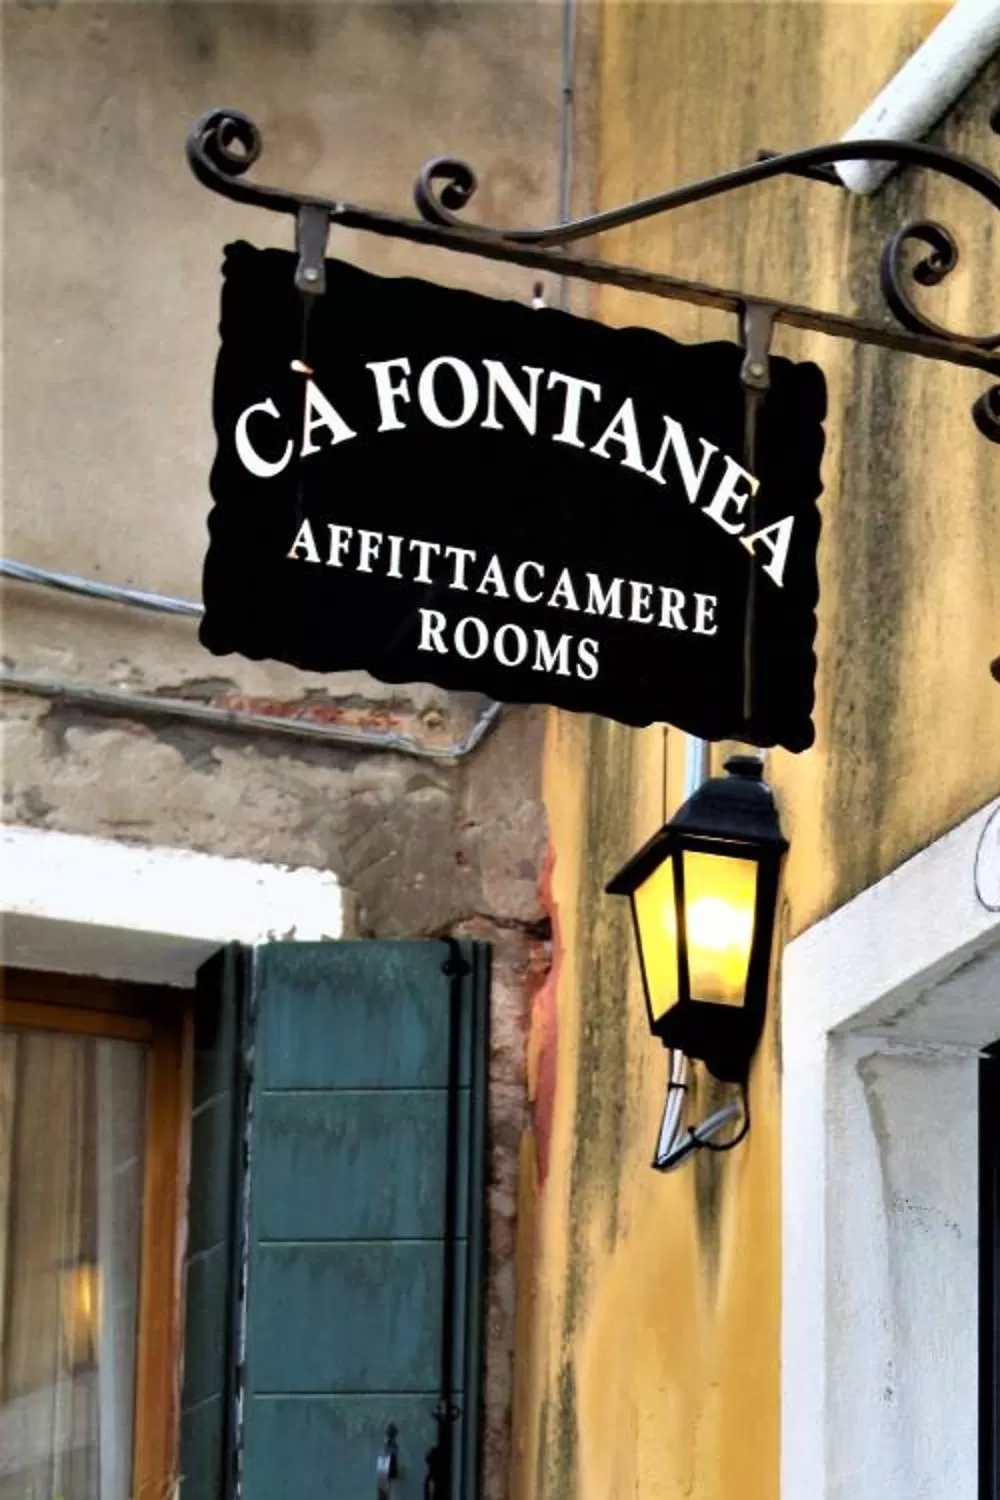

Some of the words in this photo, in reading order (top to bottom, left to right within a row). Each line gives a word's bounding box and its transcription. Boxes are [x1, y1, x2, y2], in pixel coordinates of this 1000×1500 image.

[366, 355, 795, 588] FONTANEA
[287, 518, 718, 636] AFFITTACAMERE
[417, 607, 600, 681] ROOMS
